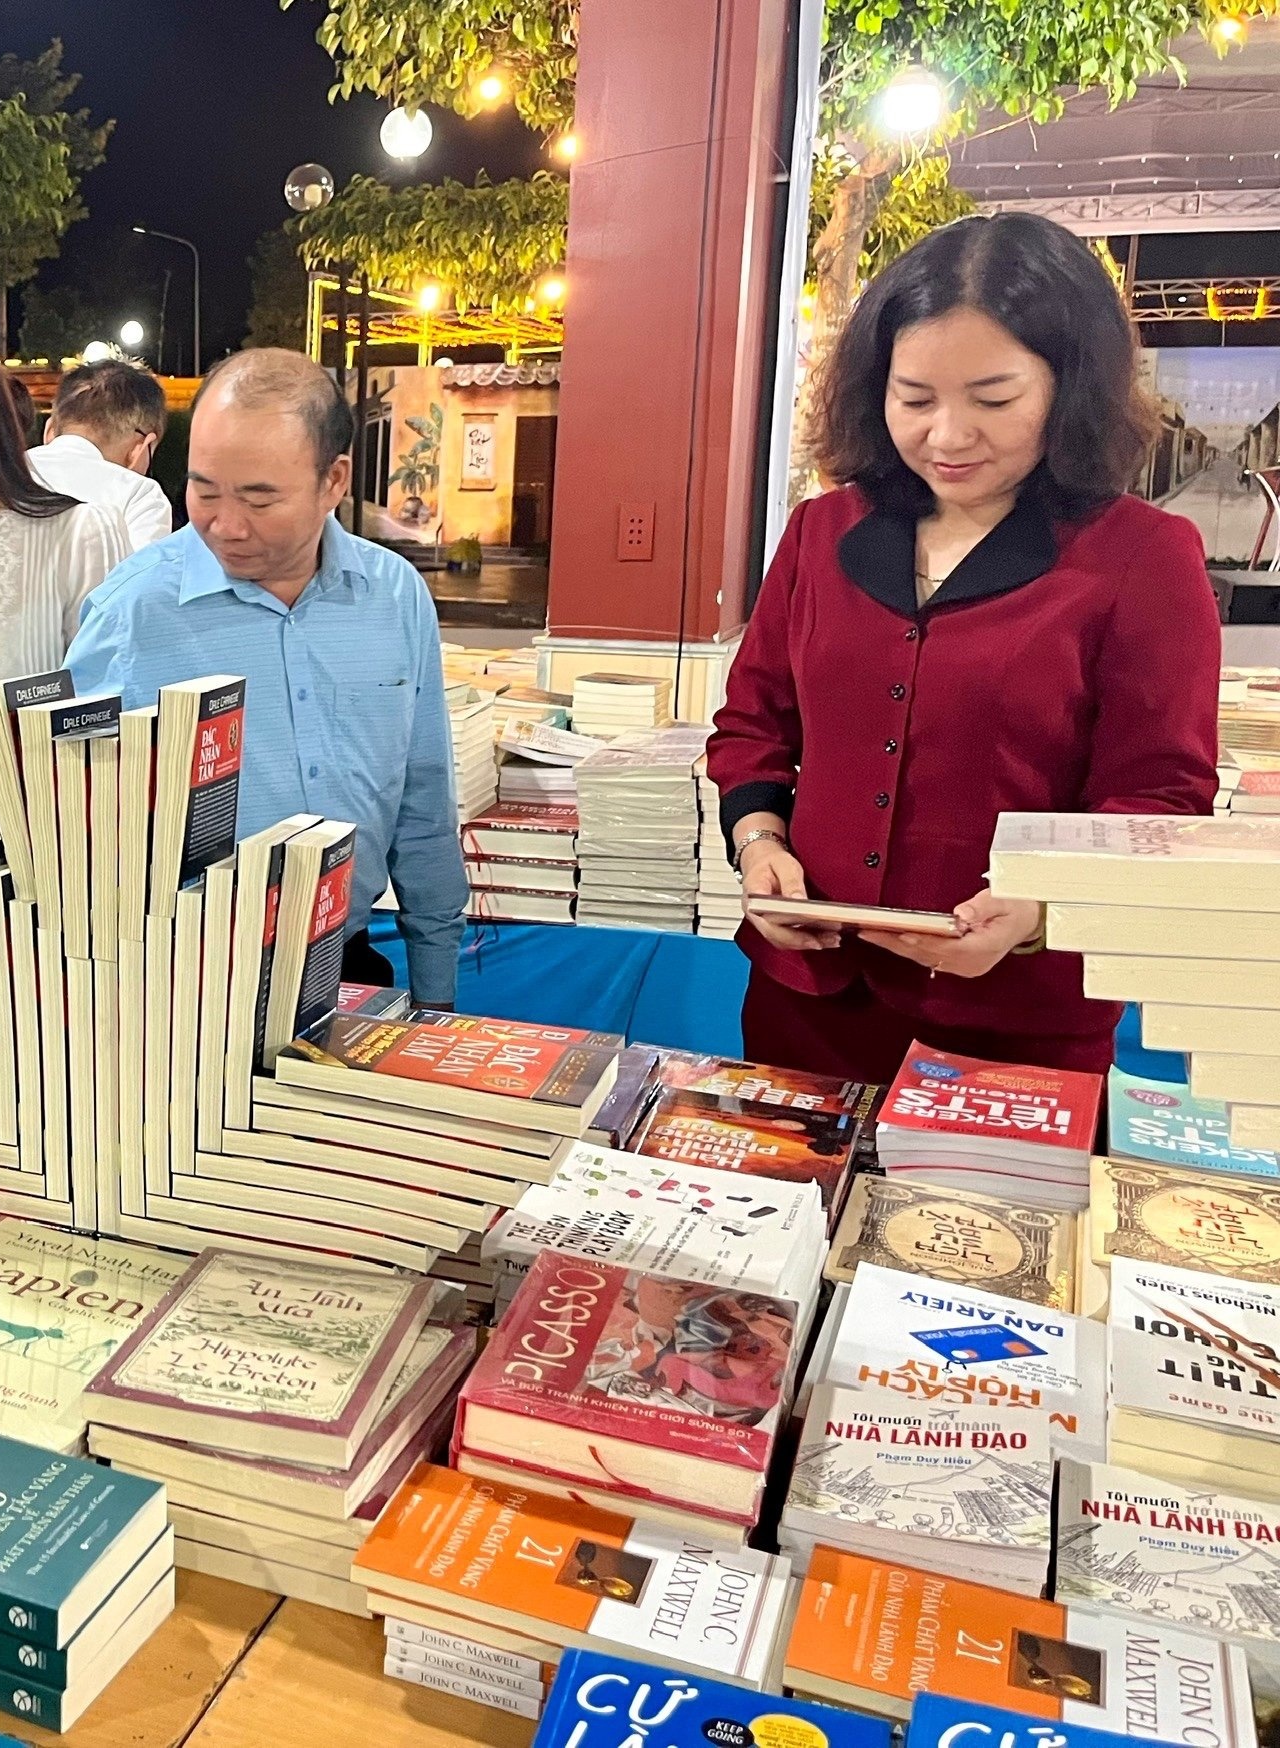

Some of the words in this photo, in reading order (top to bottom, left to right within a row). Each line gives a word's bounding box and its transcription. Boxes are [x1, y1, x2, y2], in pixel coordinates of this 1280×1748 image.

[17, 689, 32, 701] DALE
[33, 682, 61, 698] CARNEGIE
[63, 718, 80, 729] DALE
[81, 709, 112, 723] CARNEGIE
[898, 1086, 1072, 1125] IELTS
[920, 1078, 1059, 1106] Listening
[891, 1101, 1068, 1135] HACKERS
[508, 1222, 534, 1239] THE
[531, 1215, 570, 1246] DESIGN
[559, 1210, 605, 1250] THINKING
[582, 1210, 635, 1258] PLAYBOOK
[17, 1231, 73, 1258] Yuval
[76, 1244, 135, 1271] Noah
[1135, 1276, 1189, 1298] Taleb
[1192, 1289, 1276, 1317] Nicholas
[898, 1290, 997, 1323] ARIELY
[503, 1266, 607, 1381] PICASSO
[1002, 1315, 1064, 1338] DAN
[190, 1337, 318, 1371] Hippolyte
[169, 1351, 208, 1371] Le
[216, 1361, 317, 1391] Breton
[1156, 1357, 1277, 1400] THỊT
[547, 1388, 589, 1404] TRANH
[825, 1421, 883, 1442] NHÀ
[890, 1421, 963, 1449] LÃNH
[970, 1431, 1028, 1450] ĐẠO
[852, 1412, 875, 1424] Tôi
[877, 1415, 922, 1427] muốn
[876, 1452, 913, 1463] Phạm
[916, 1455, 940, 1466] Duy
[515, 1536, 563, 1567] 21
[649, 1542, 713, 1641] MAXWELL
[710, 1560, 755, 1623] JOHN
[421, 1630, 449, 1647] JOHN
[466, 1645, 521, 1669] MAXWELL
[955, 1629, 1004, 1665] 21
[576, 1672, 699, 1726] CỨ
[707, 1729, 744, 1744] GOING
[715, 1721, 744, 1735] KEEP
